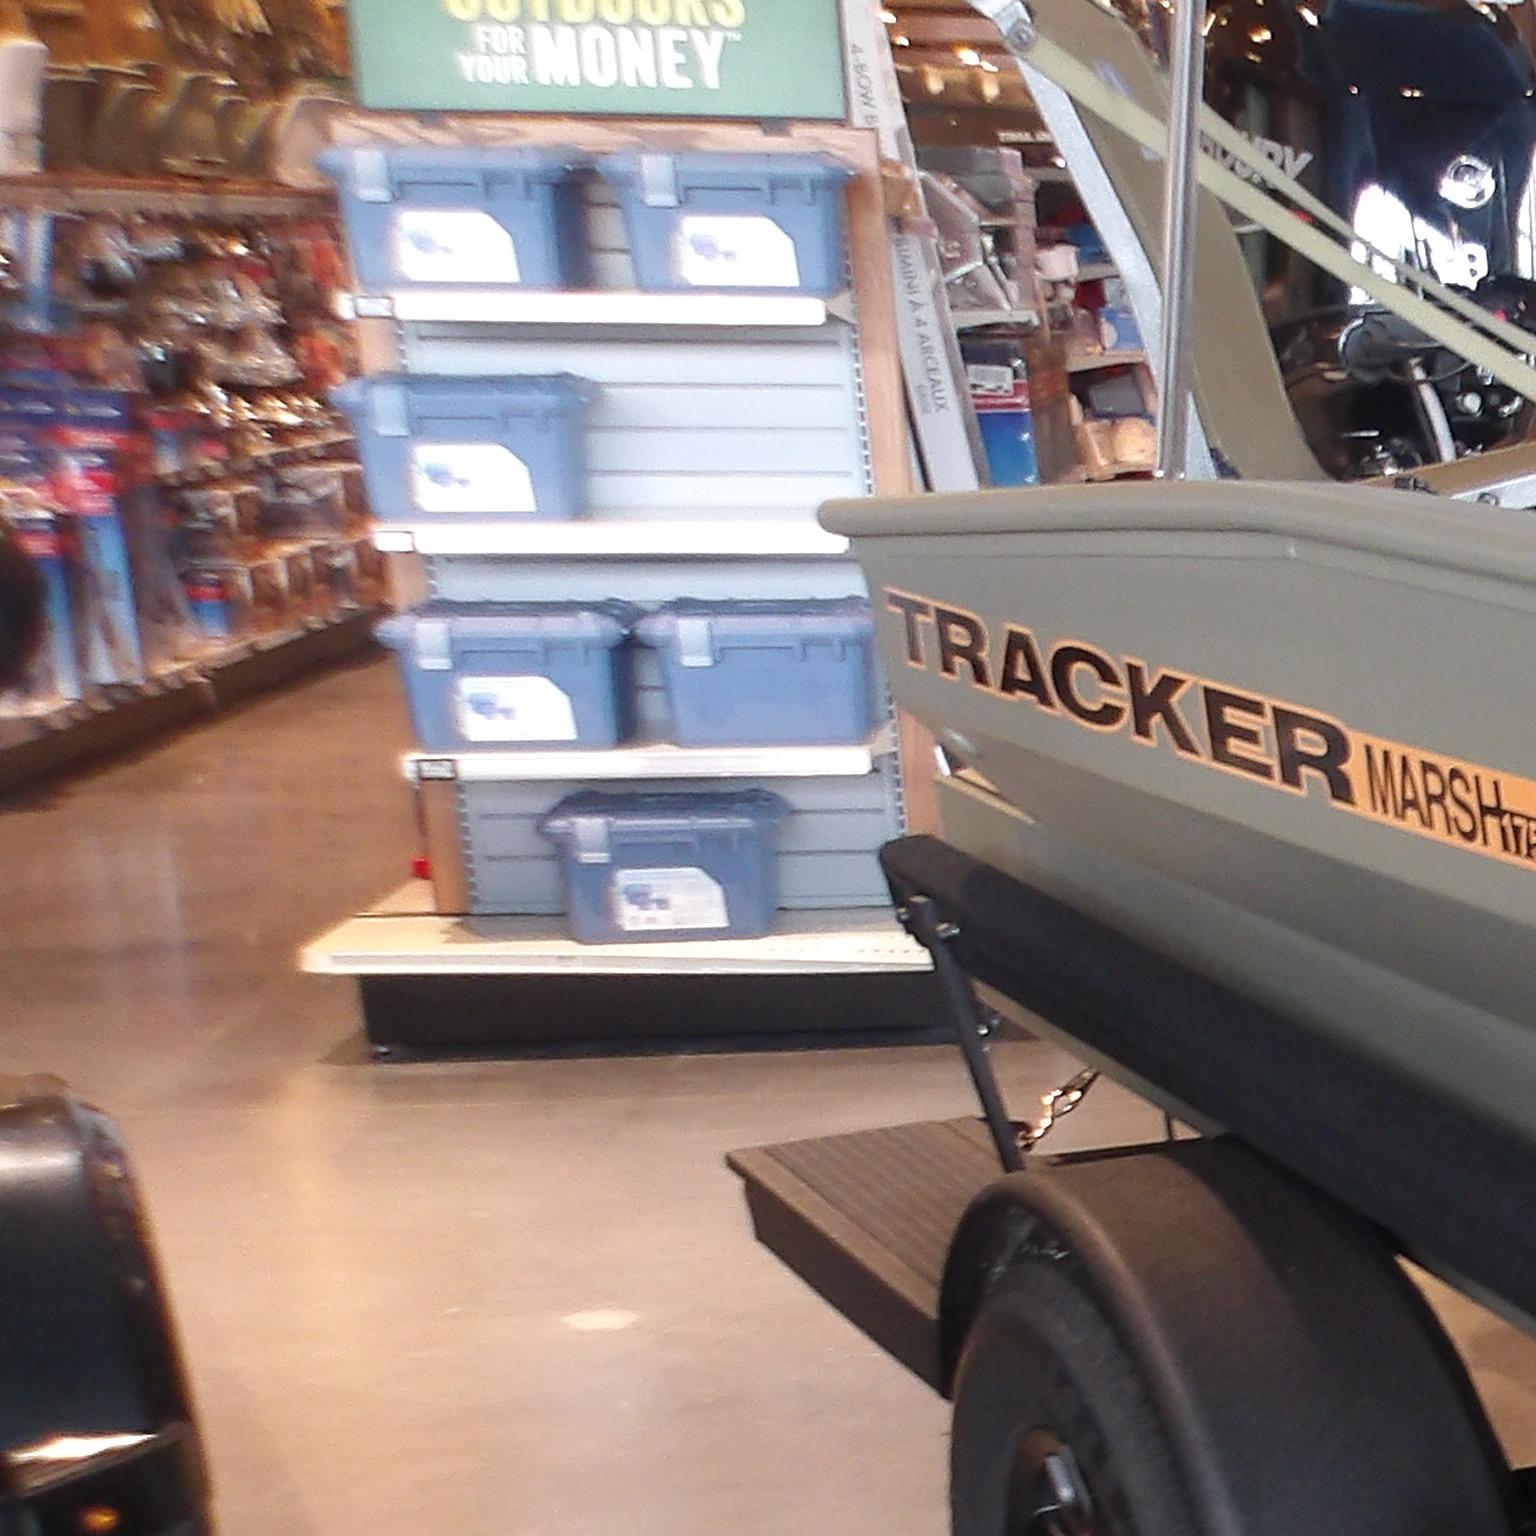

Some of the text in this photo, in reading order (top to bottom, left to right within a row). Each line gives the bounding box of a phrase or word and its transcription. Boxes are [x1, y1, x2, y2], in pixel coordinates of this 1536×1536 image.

[474, 25, 527, 54] FOR
[532, 25, 724, 90] MONEY
[458, 55, 529, 85] YOUR
[885, 588, 1361, 810] TRACKER
[1364, 743, 1503, 847] MARSH
